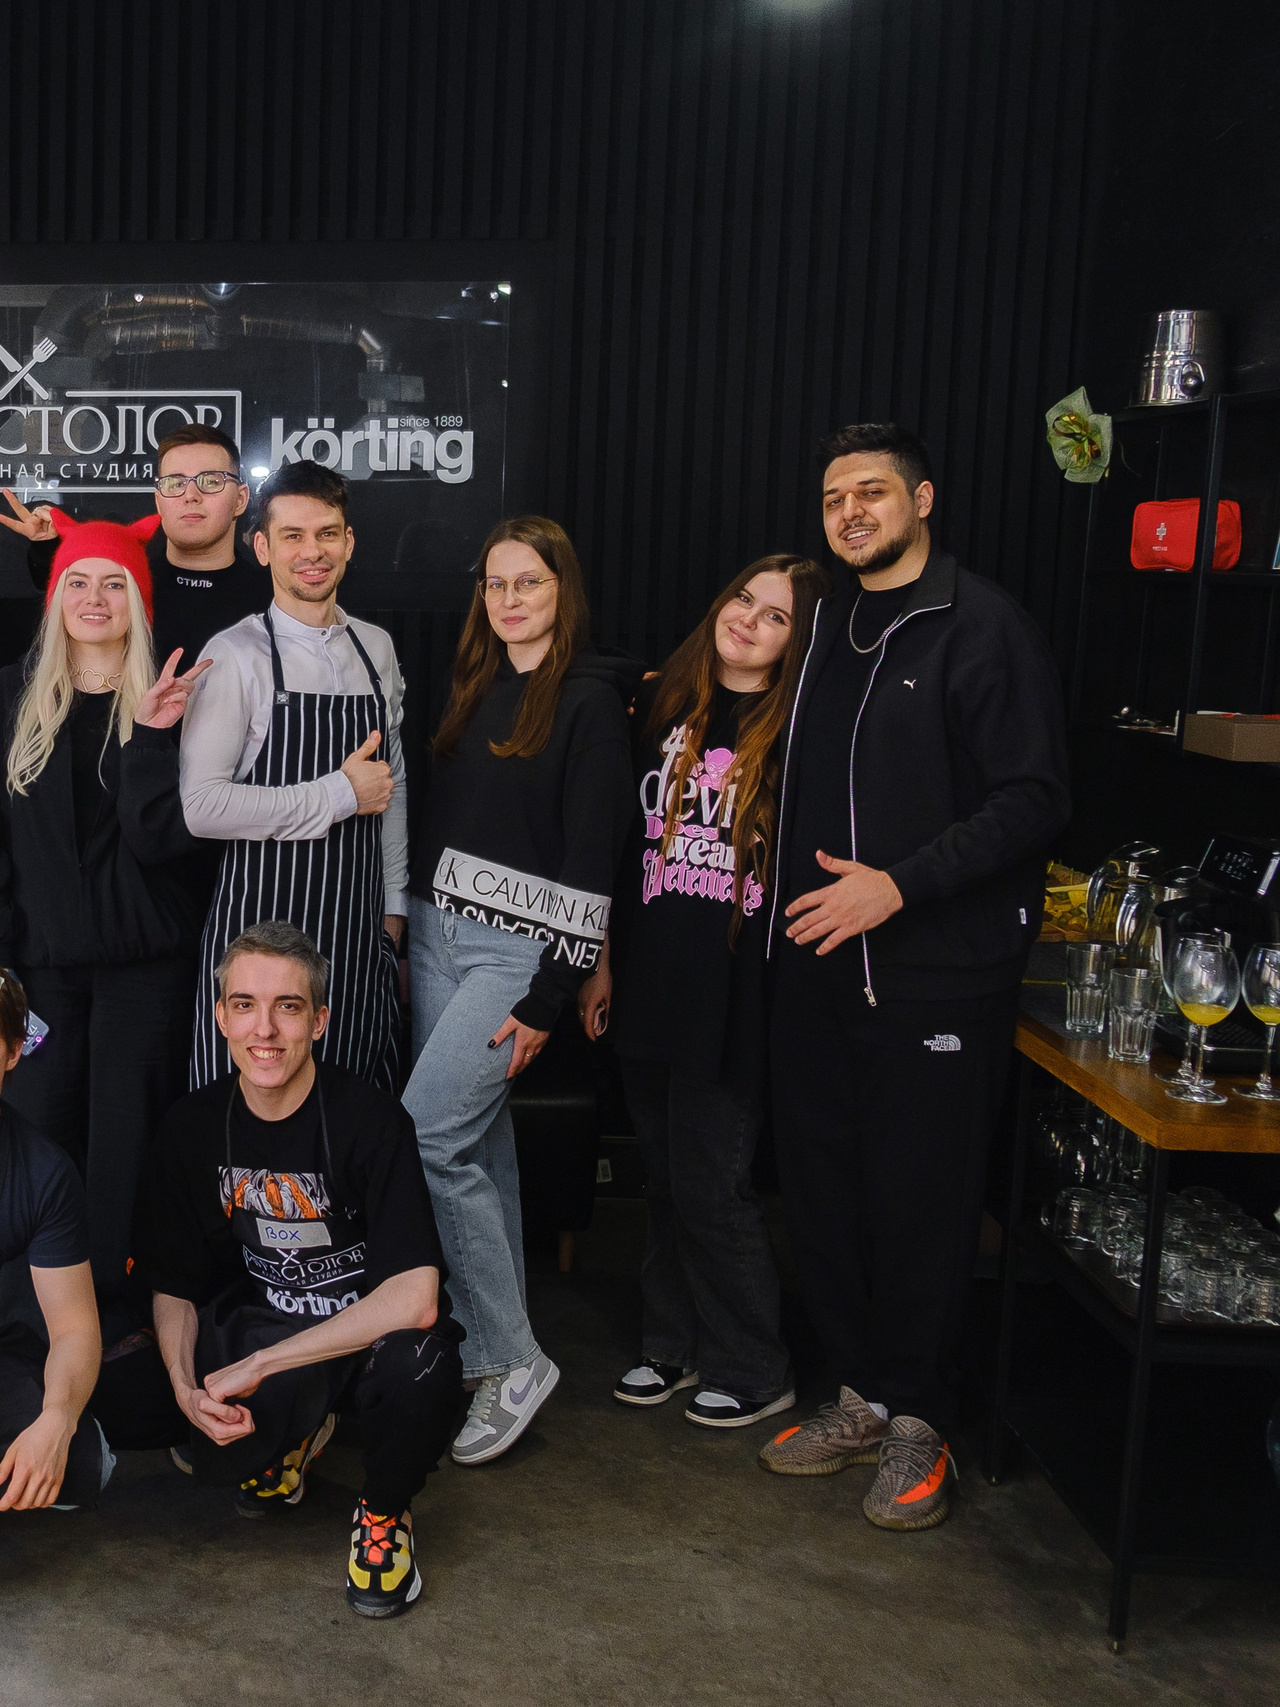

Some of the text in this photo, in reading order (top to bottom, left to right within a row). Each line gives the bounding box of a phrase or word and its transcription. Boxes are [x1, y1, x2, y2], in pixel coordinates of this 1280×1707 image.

[399, 416, 463, 428] since 1889
[271, 418, 474, 484] körting
[60, 463, 153, 481] СТУДИЯ
[176, 576, 213, 588] СТИЛЬ
[281, 1250, 364, 1281] СТОЛОВ
[310, 1268, 343, 1283] СТУДИЯ
